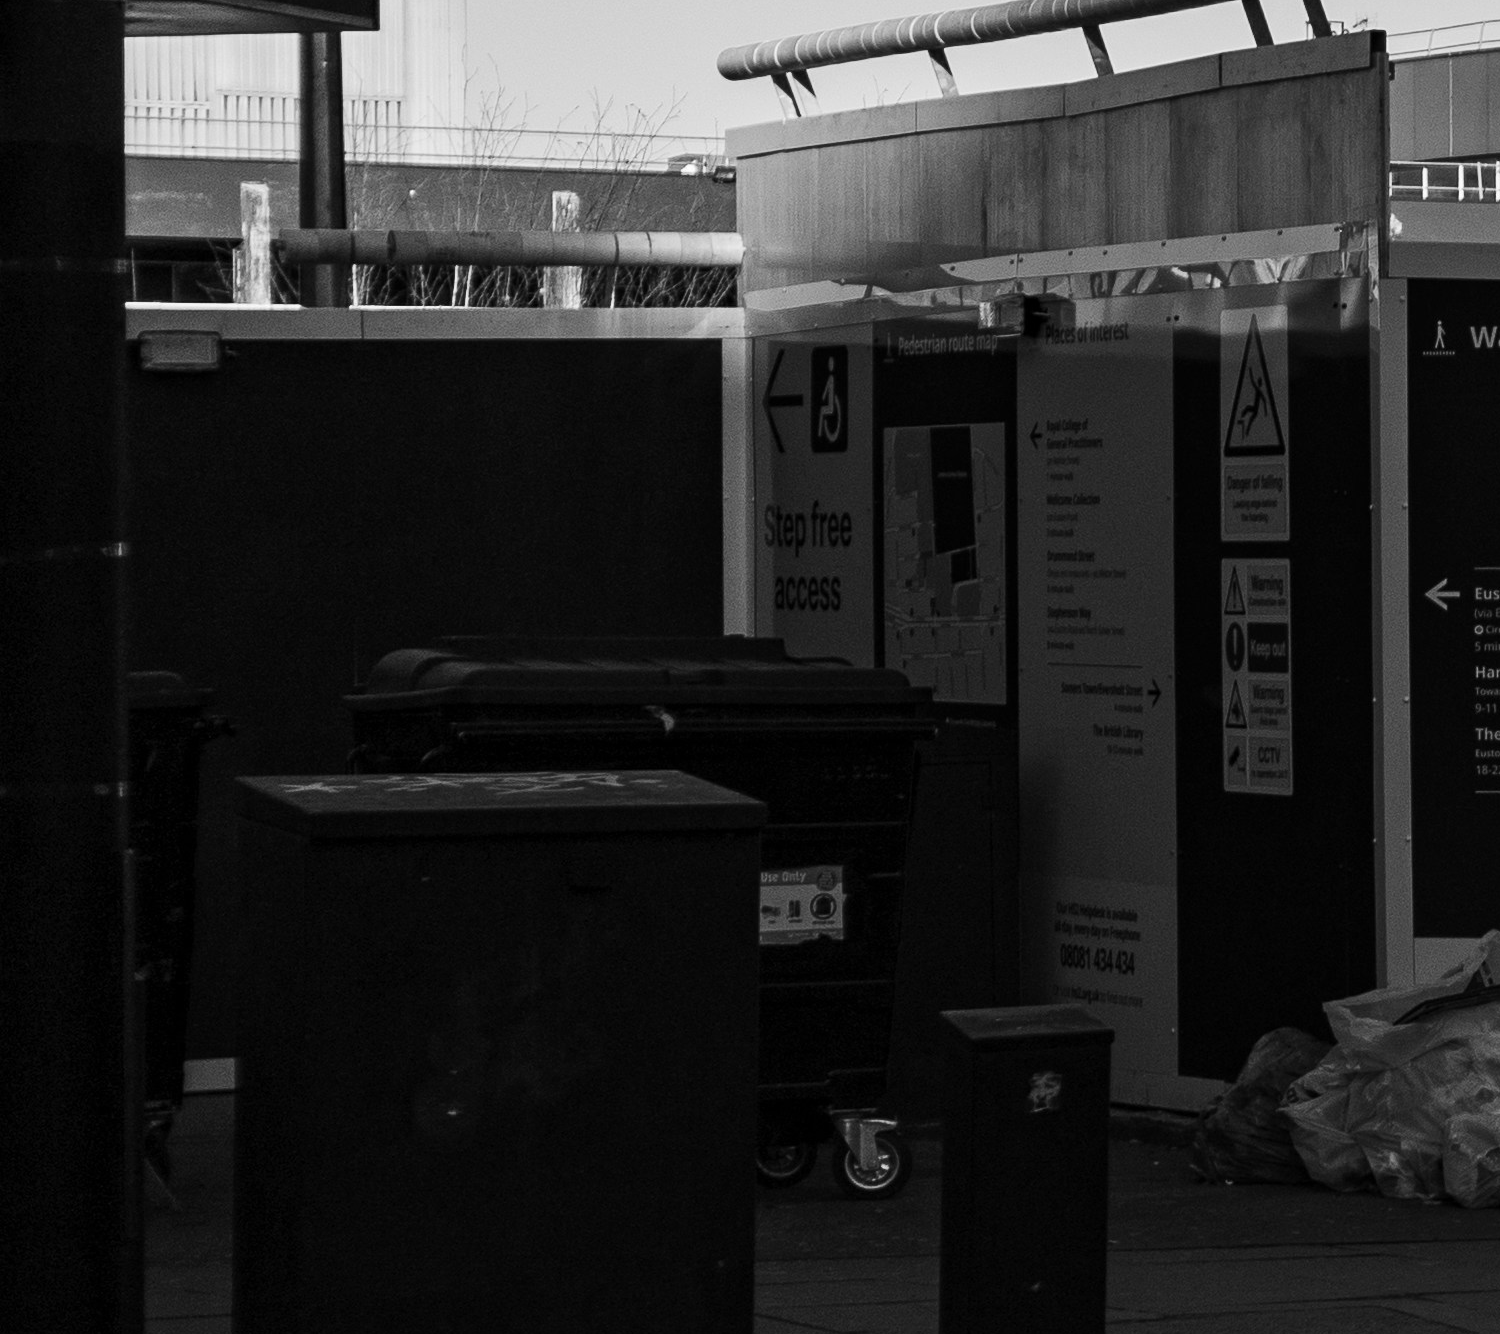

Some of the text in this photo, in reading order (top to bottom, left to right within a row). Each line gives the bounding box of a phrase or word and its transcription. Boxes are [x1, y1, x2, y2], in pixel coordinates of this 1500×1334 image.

[1045, 324, 1075, 345] Places
[1089, 322, 1129, 343] interest
[898, 334, 998, 355] Pedestrian route map
[764, 500, 852, 557] Step free
[775, 573, 841, 612] access
[1473, 608, 1493, 619] (via
[1250, 638, 1286, 660] Keep out
[1474, 640, 1481, 652] 5
[1474, 702, 1497, 713] 9-11
[761, 871, 807, 883] Use Only
